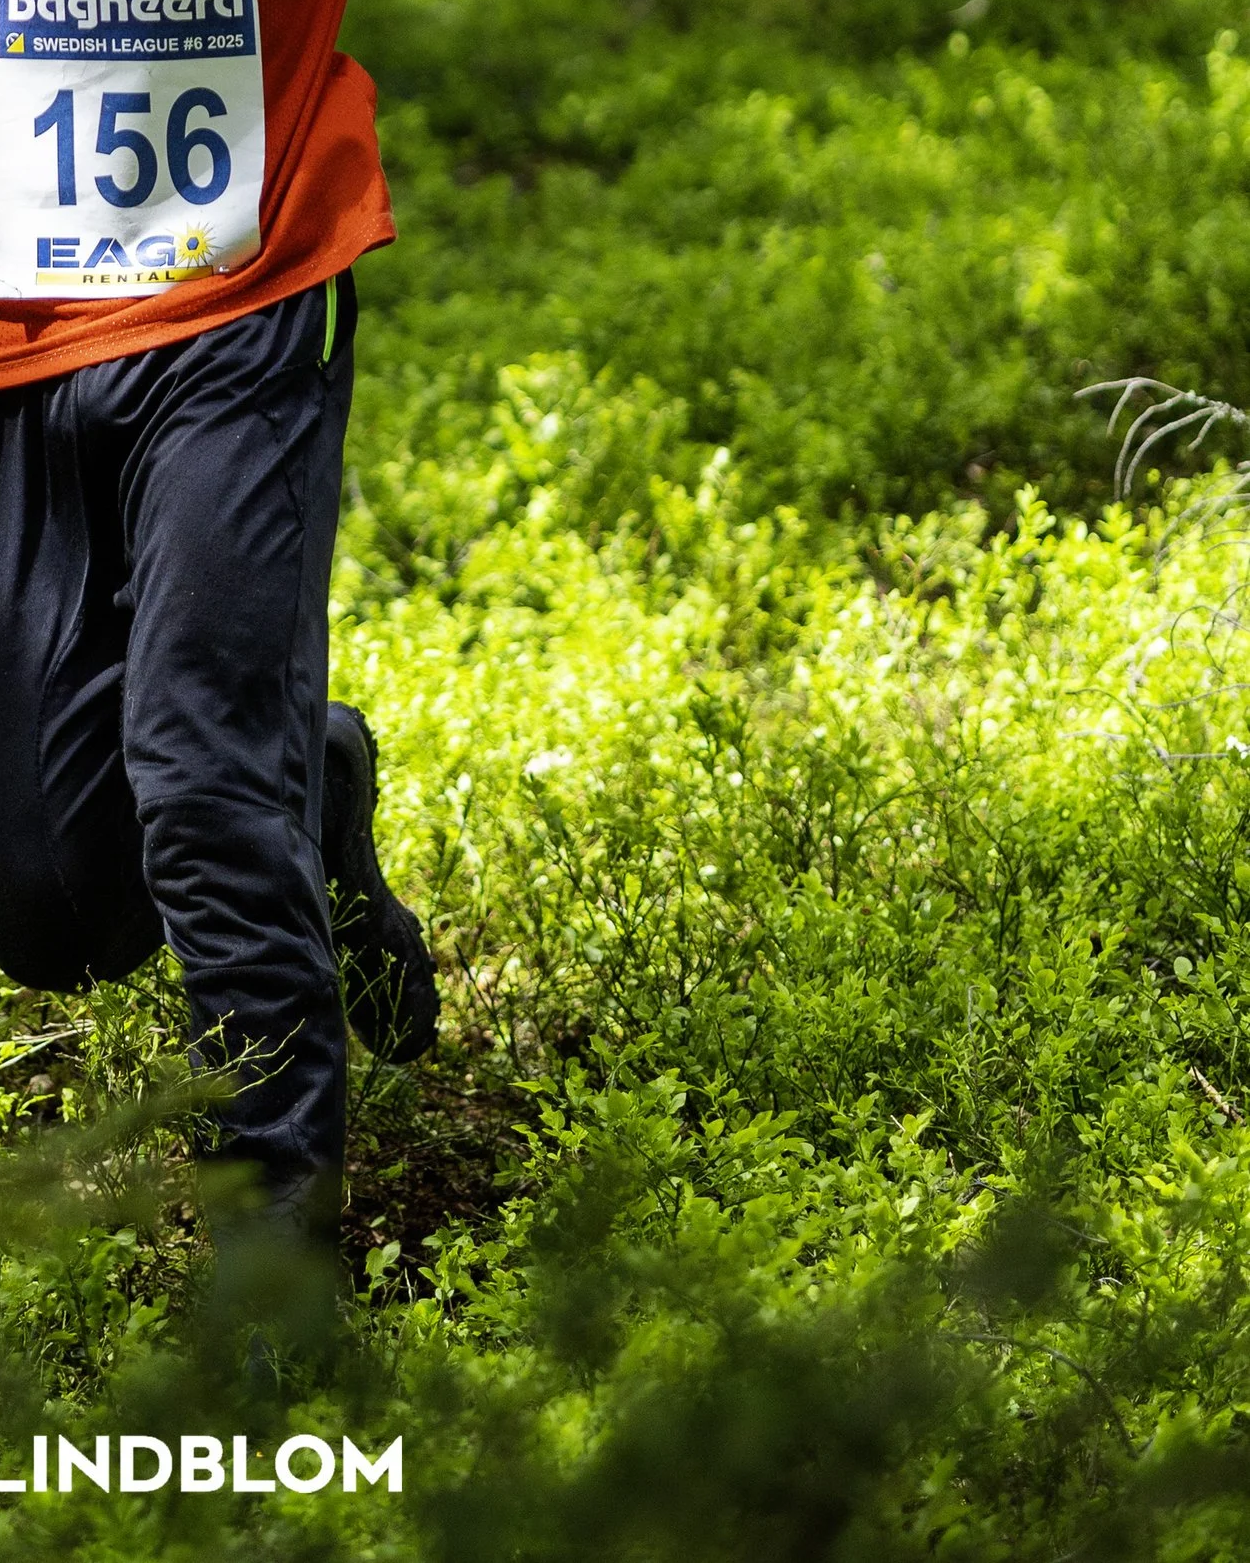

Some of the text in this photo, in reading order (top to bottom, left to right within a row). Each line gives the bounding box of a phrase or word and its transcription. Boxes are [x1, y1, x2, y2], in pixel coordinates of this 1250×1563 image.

[33, 34, 244, 53] SWEDISH LEAGUE #6 2025
[34, 87, 231, 208] 156
[83, 270, 176, 284] RENTAL
